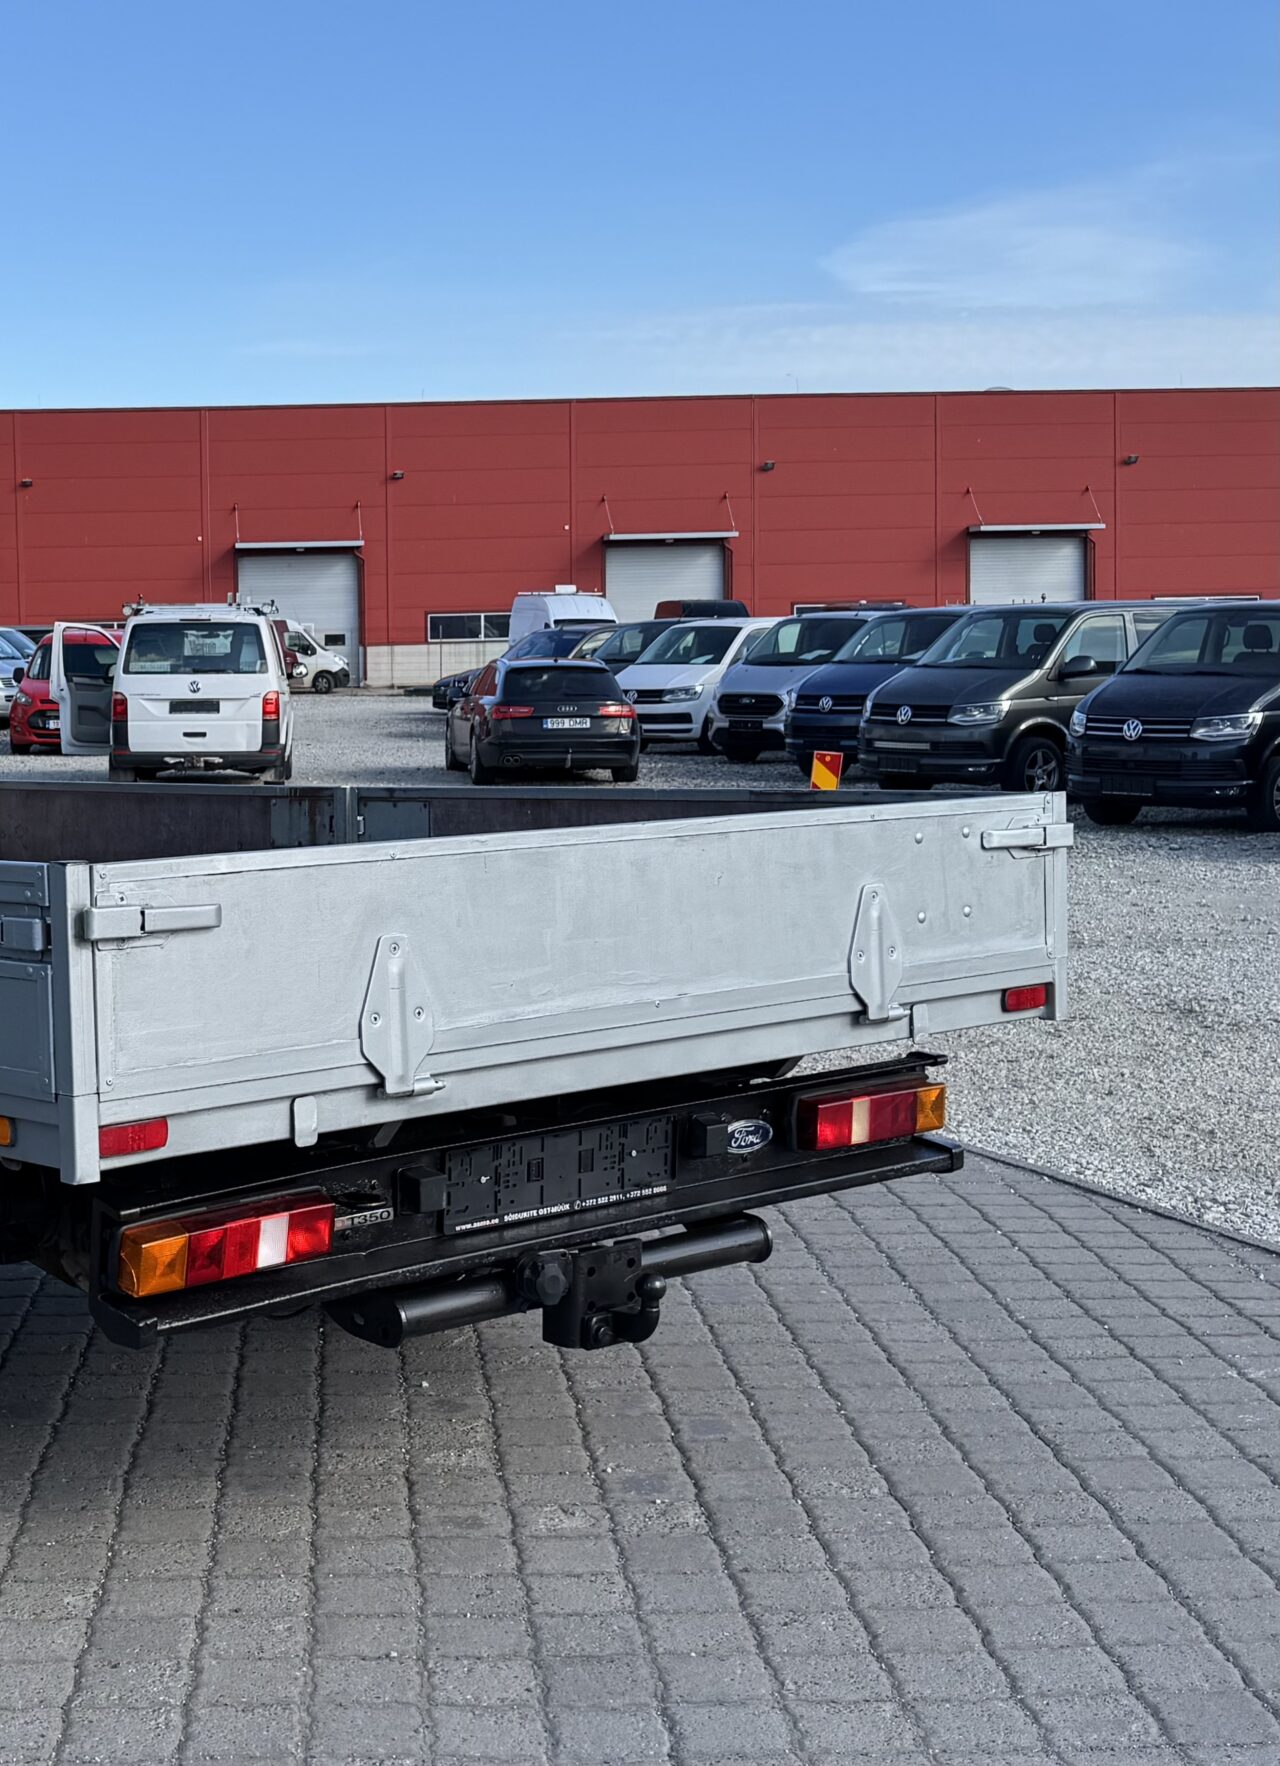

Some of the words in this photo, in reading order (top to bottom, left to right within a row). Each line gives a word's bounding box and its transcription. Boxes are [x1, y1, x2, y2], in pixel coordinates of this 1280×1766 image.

[549, 719, 565, 728] 999
[568, 718, 588, 727] DMR
[731, 1126, 763, 1148] Ford
[346, 1210, 391, 1226] T350
